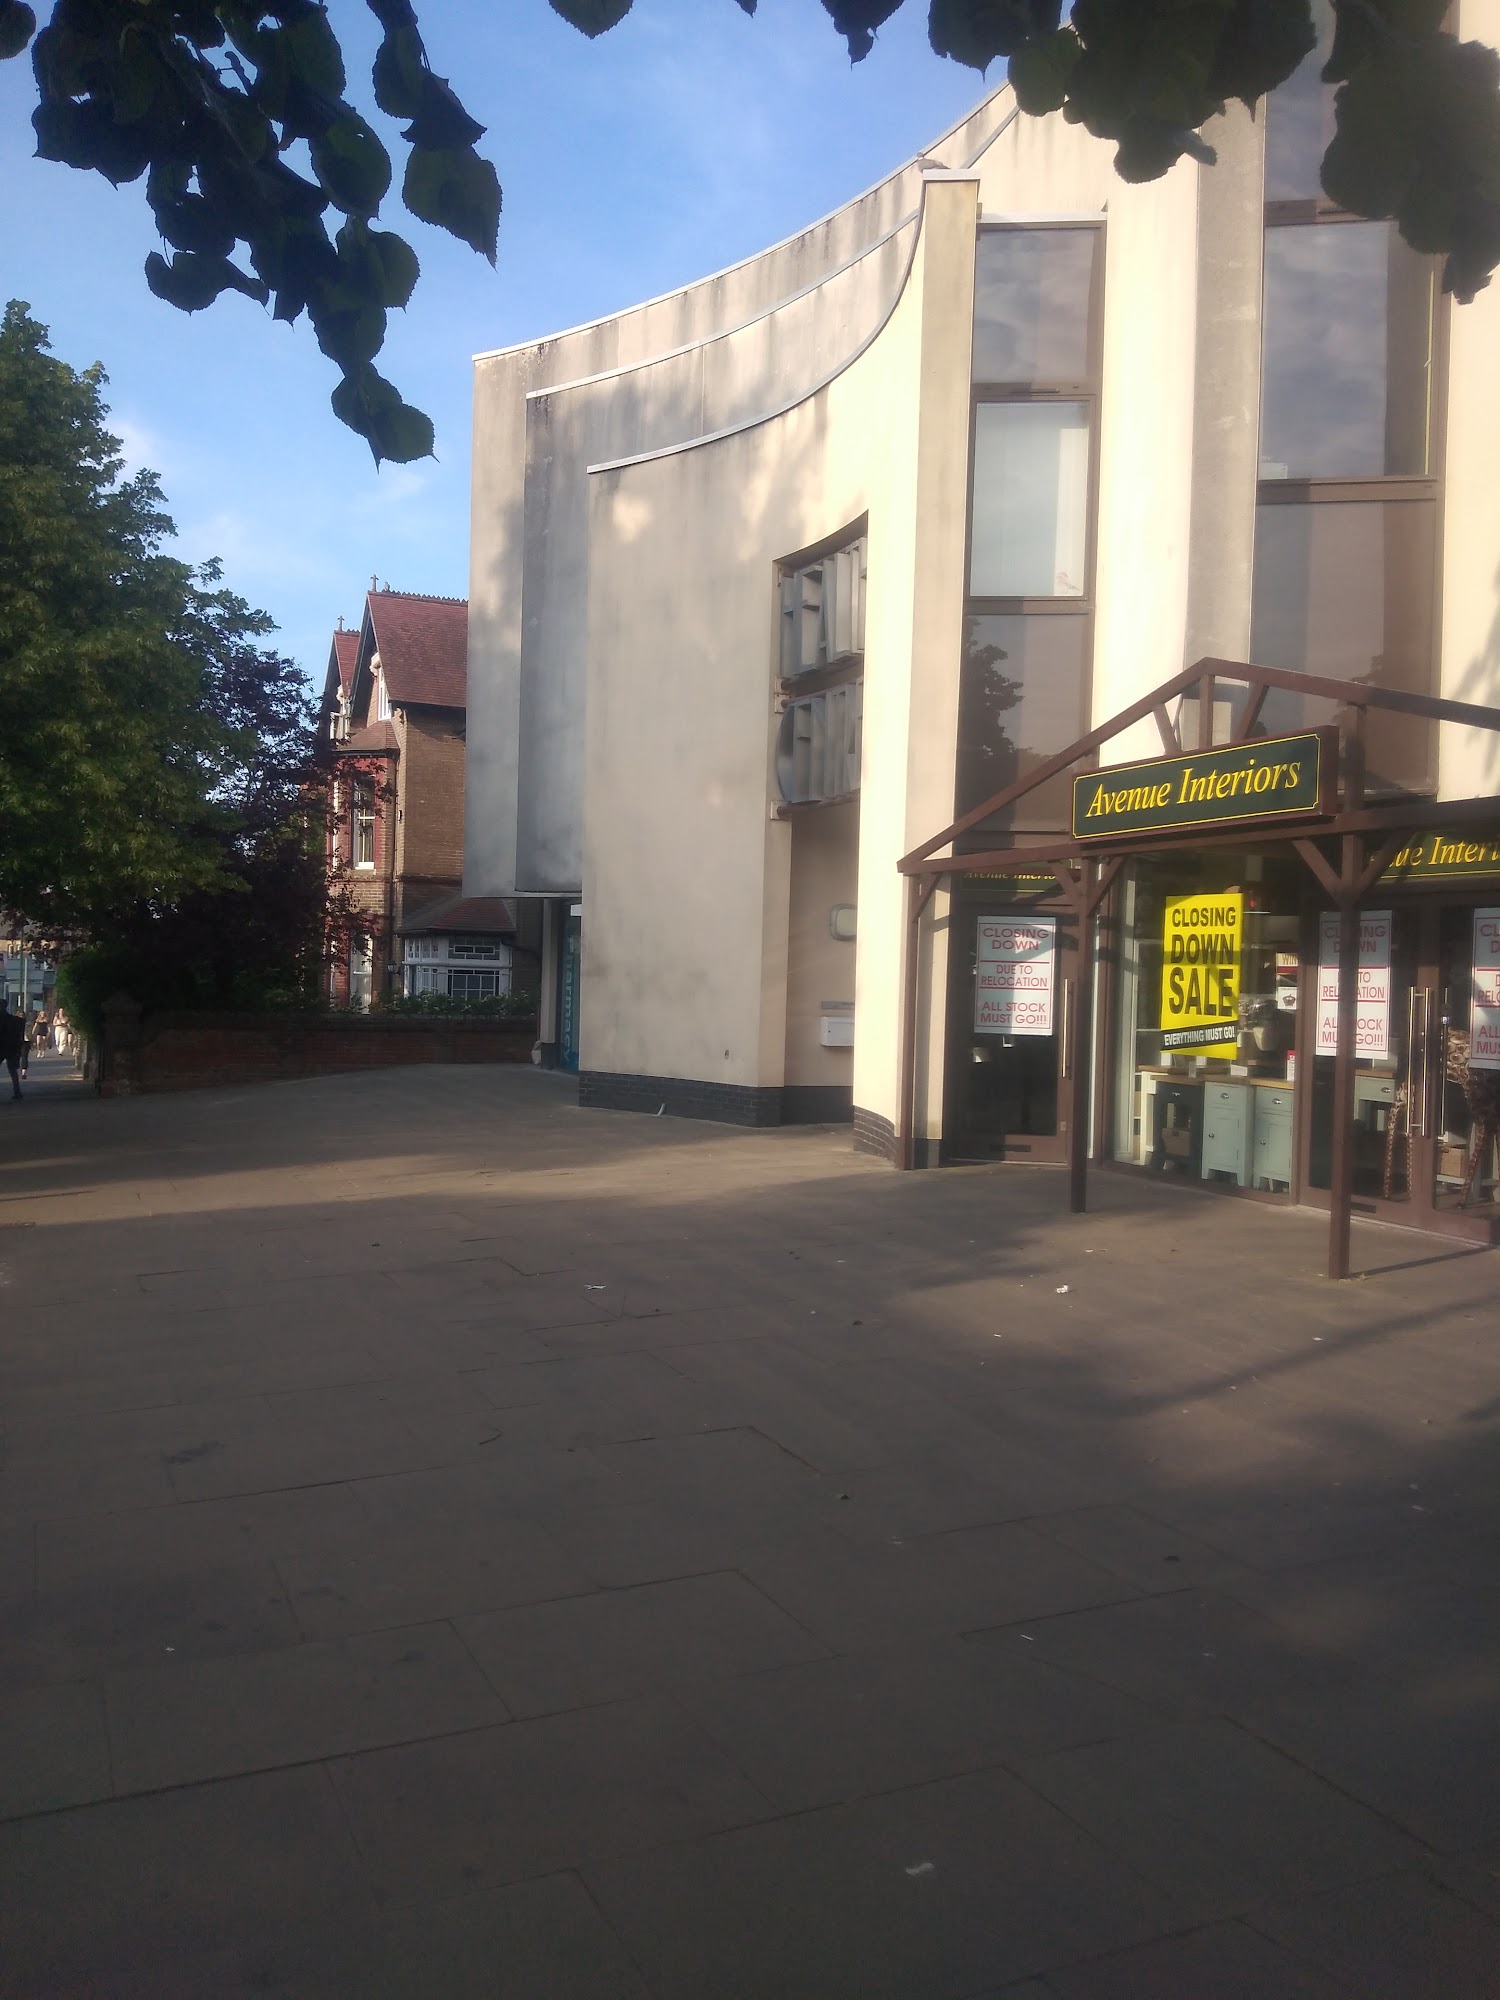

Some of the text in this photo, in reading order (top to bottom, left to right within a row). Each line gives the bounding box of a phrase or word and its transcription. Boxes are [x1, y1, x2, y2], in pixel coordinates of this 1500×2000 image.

[1084, 758, 1302, 818] Avenue Interiors
[1171, 906, 1236, 928] CLOSING
[983, 927, 1050, 939] CLOSING
[991, 940, 1040, 951] DOWN
[1170, 933, 1235, 965] DOWN
[996, 964, 1033, 975] DUE TO
[981, 975, 1048, 987] RELOCATION
[1168, 966, 1234, 1017] SALE
[1322, 985, 1385, 999] RELATION
[981, 1001, 1046, 1013] ALL STOCK
[980, 1013, 1047, 1025] MUST GO!!!
[1164, 1025, 1236, 1046] EVERYTHING MUST GO!
